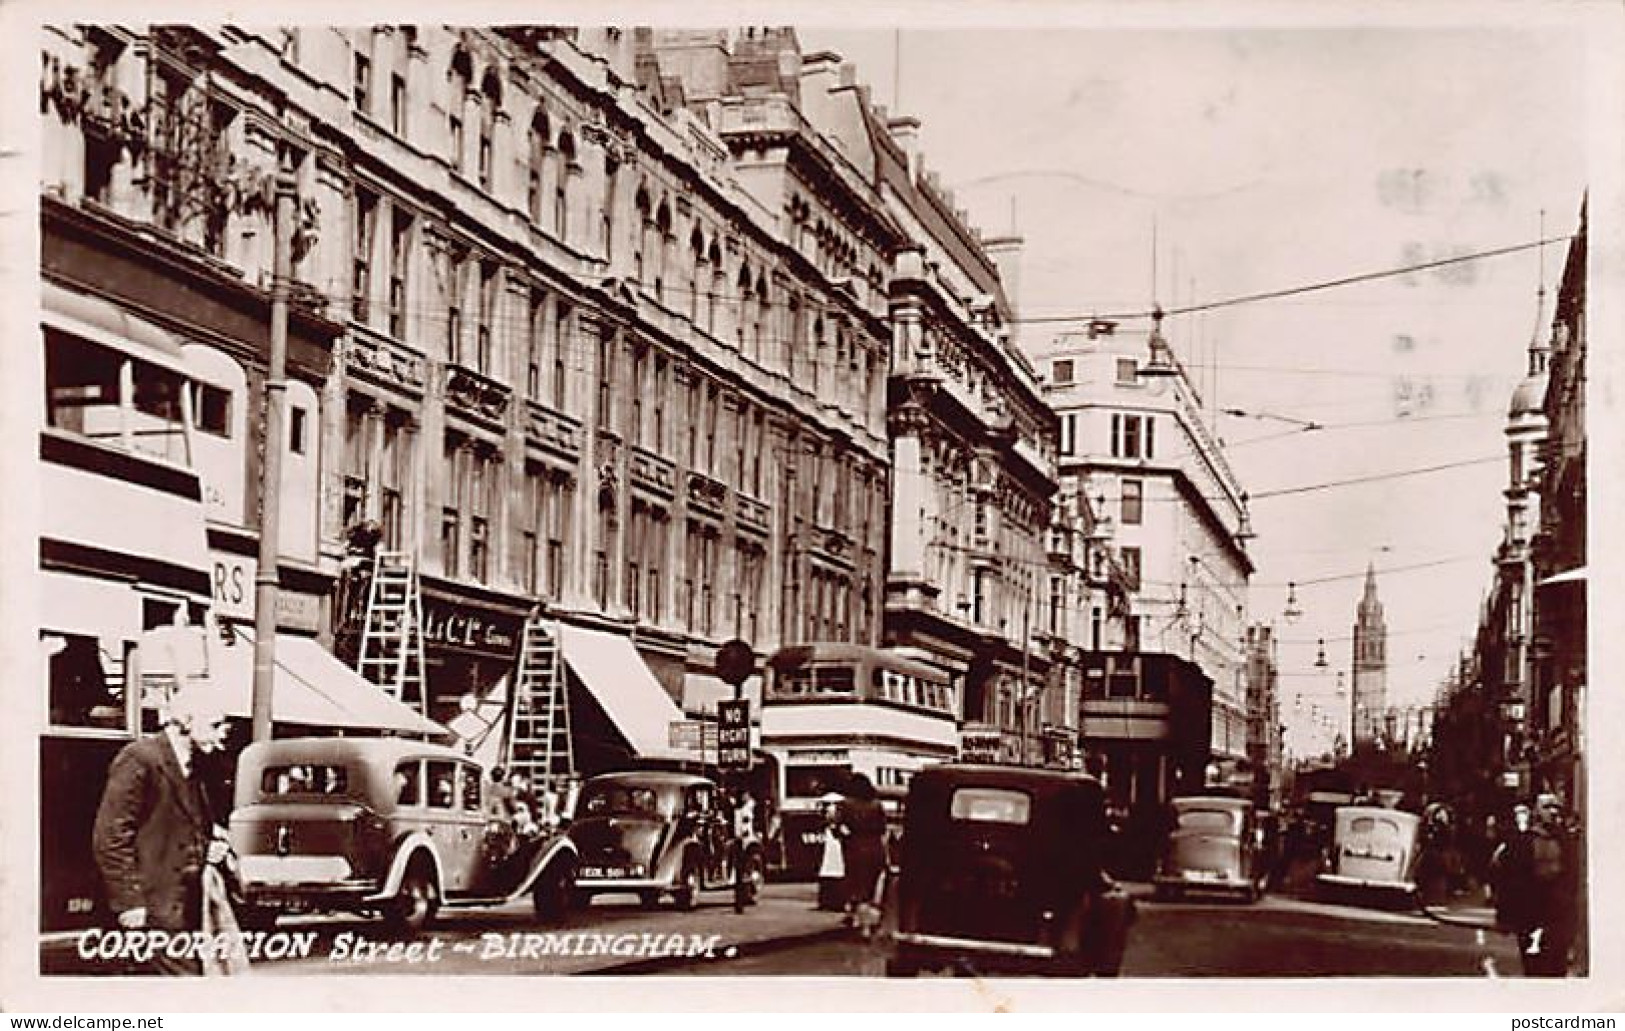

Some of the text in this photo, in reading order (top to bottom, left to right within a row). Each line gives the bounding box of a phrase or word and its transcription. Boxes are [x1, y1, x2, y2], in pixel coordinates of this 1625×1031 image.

[725, 708, 741, 722] NO
[719, 728, 747, 742] RIGHT
[720, 748, 747, 763] TURN
